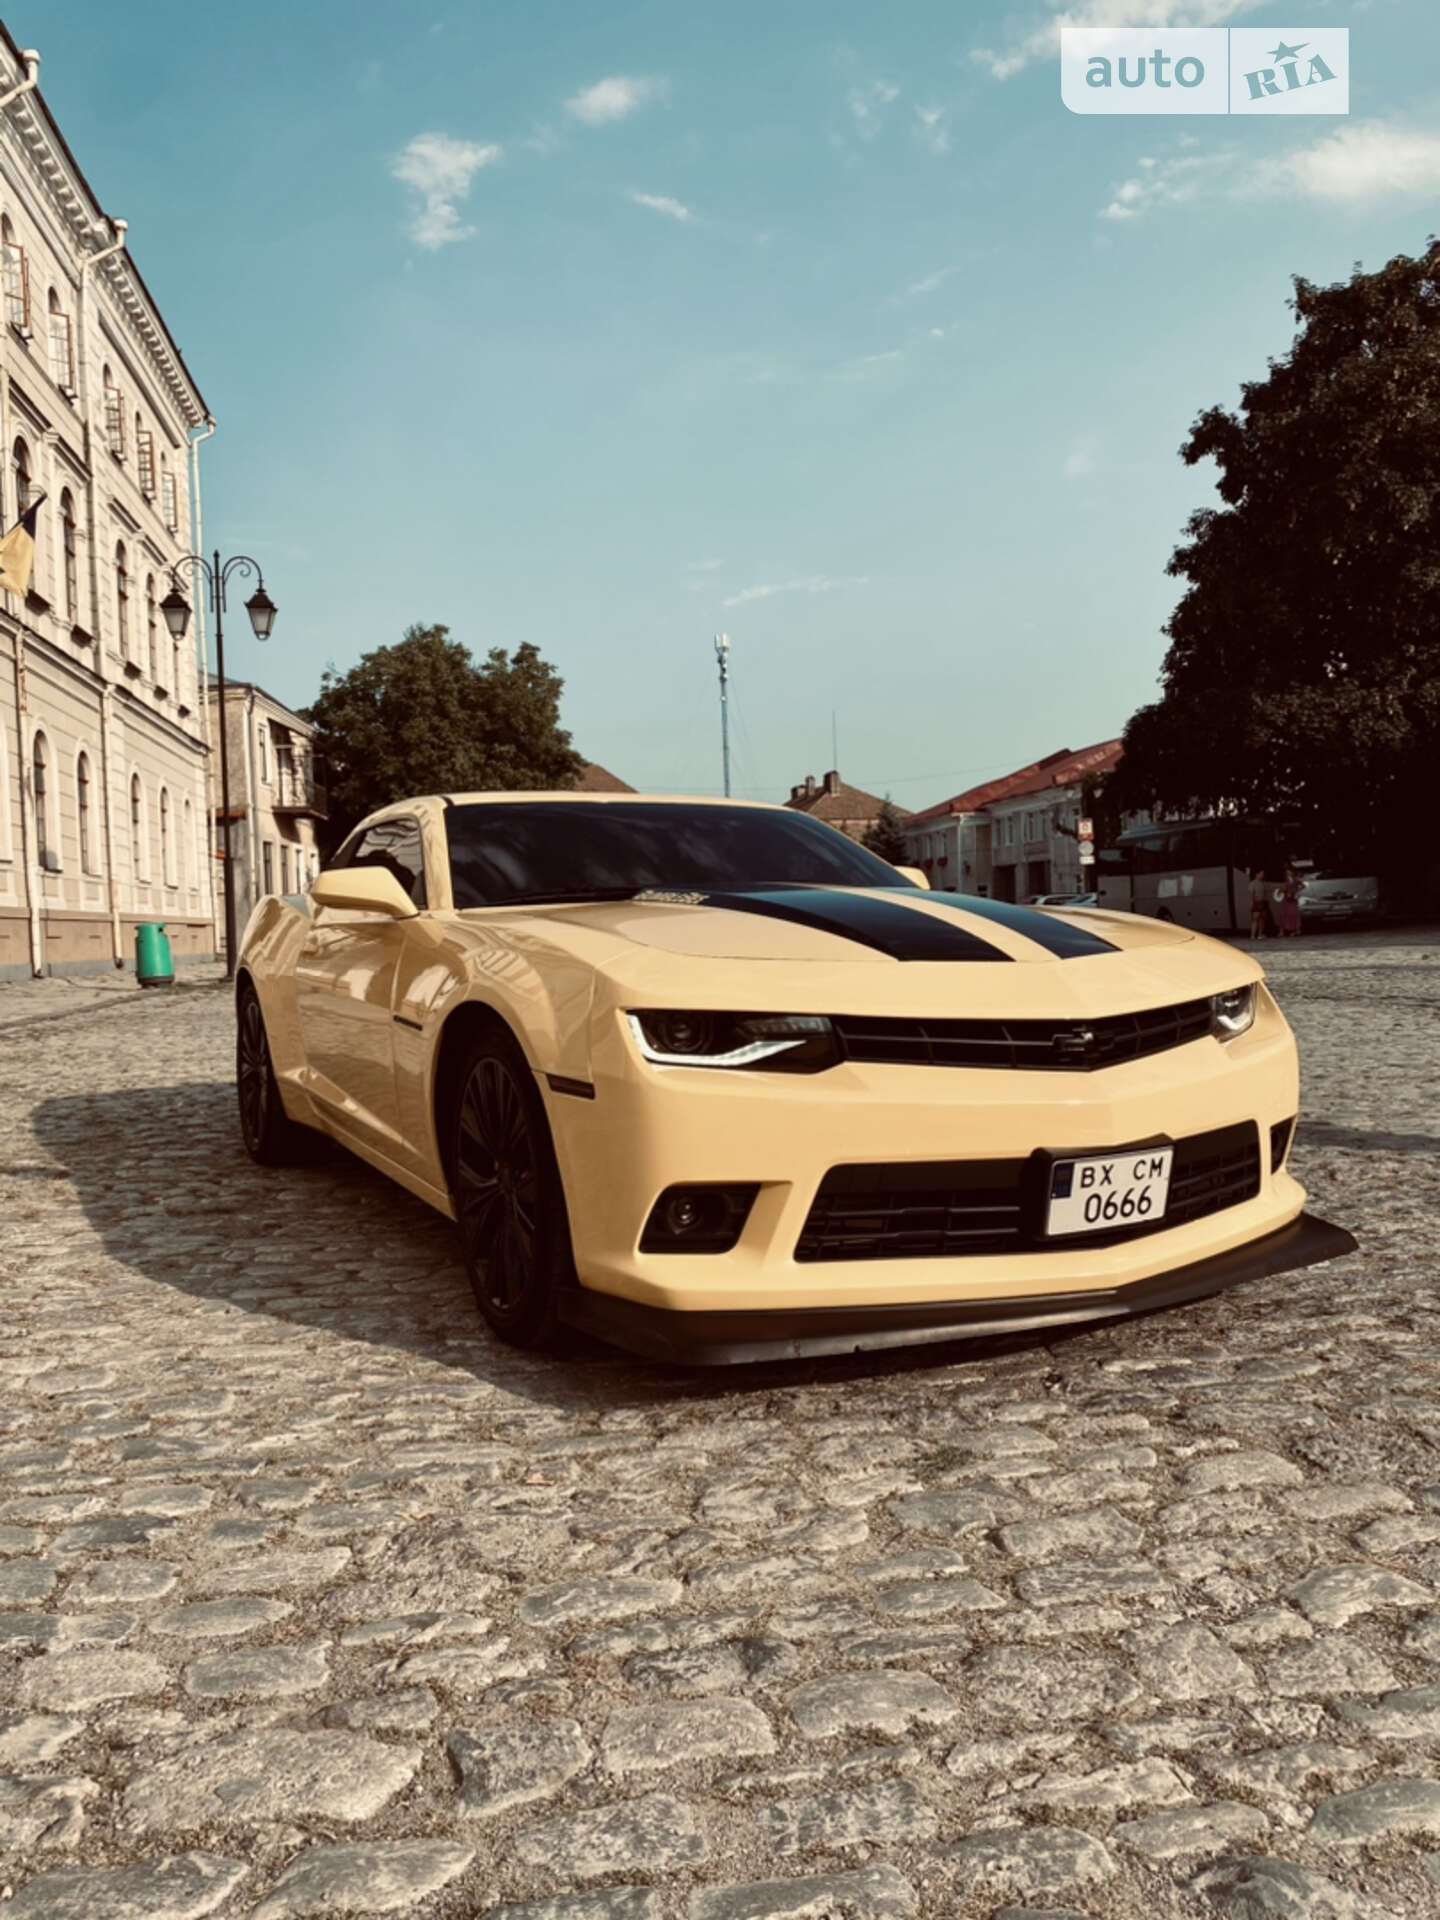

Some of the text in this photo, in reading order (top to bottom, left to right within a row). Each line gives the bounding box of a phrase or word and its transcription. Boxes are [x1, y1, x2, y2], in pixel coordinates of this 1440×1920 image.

[1080, 1156, 1164, 1189] BX CM
[1083, 1185, 1153, 1223] 0666
